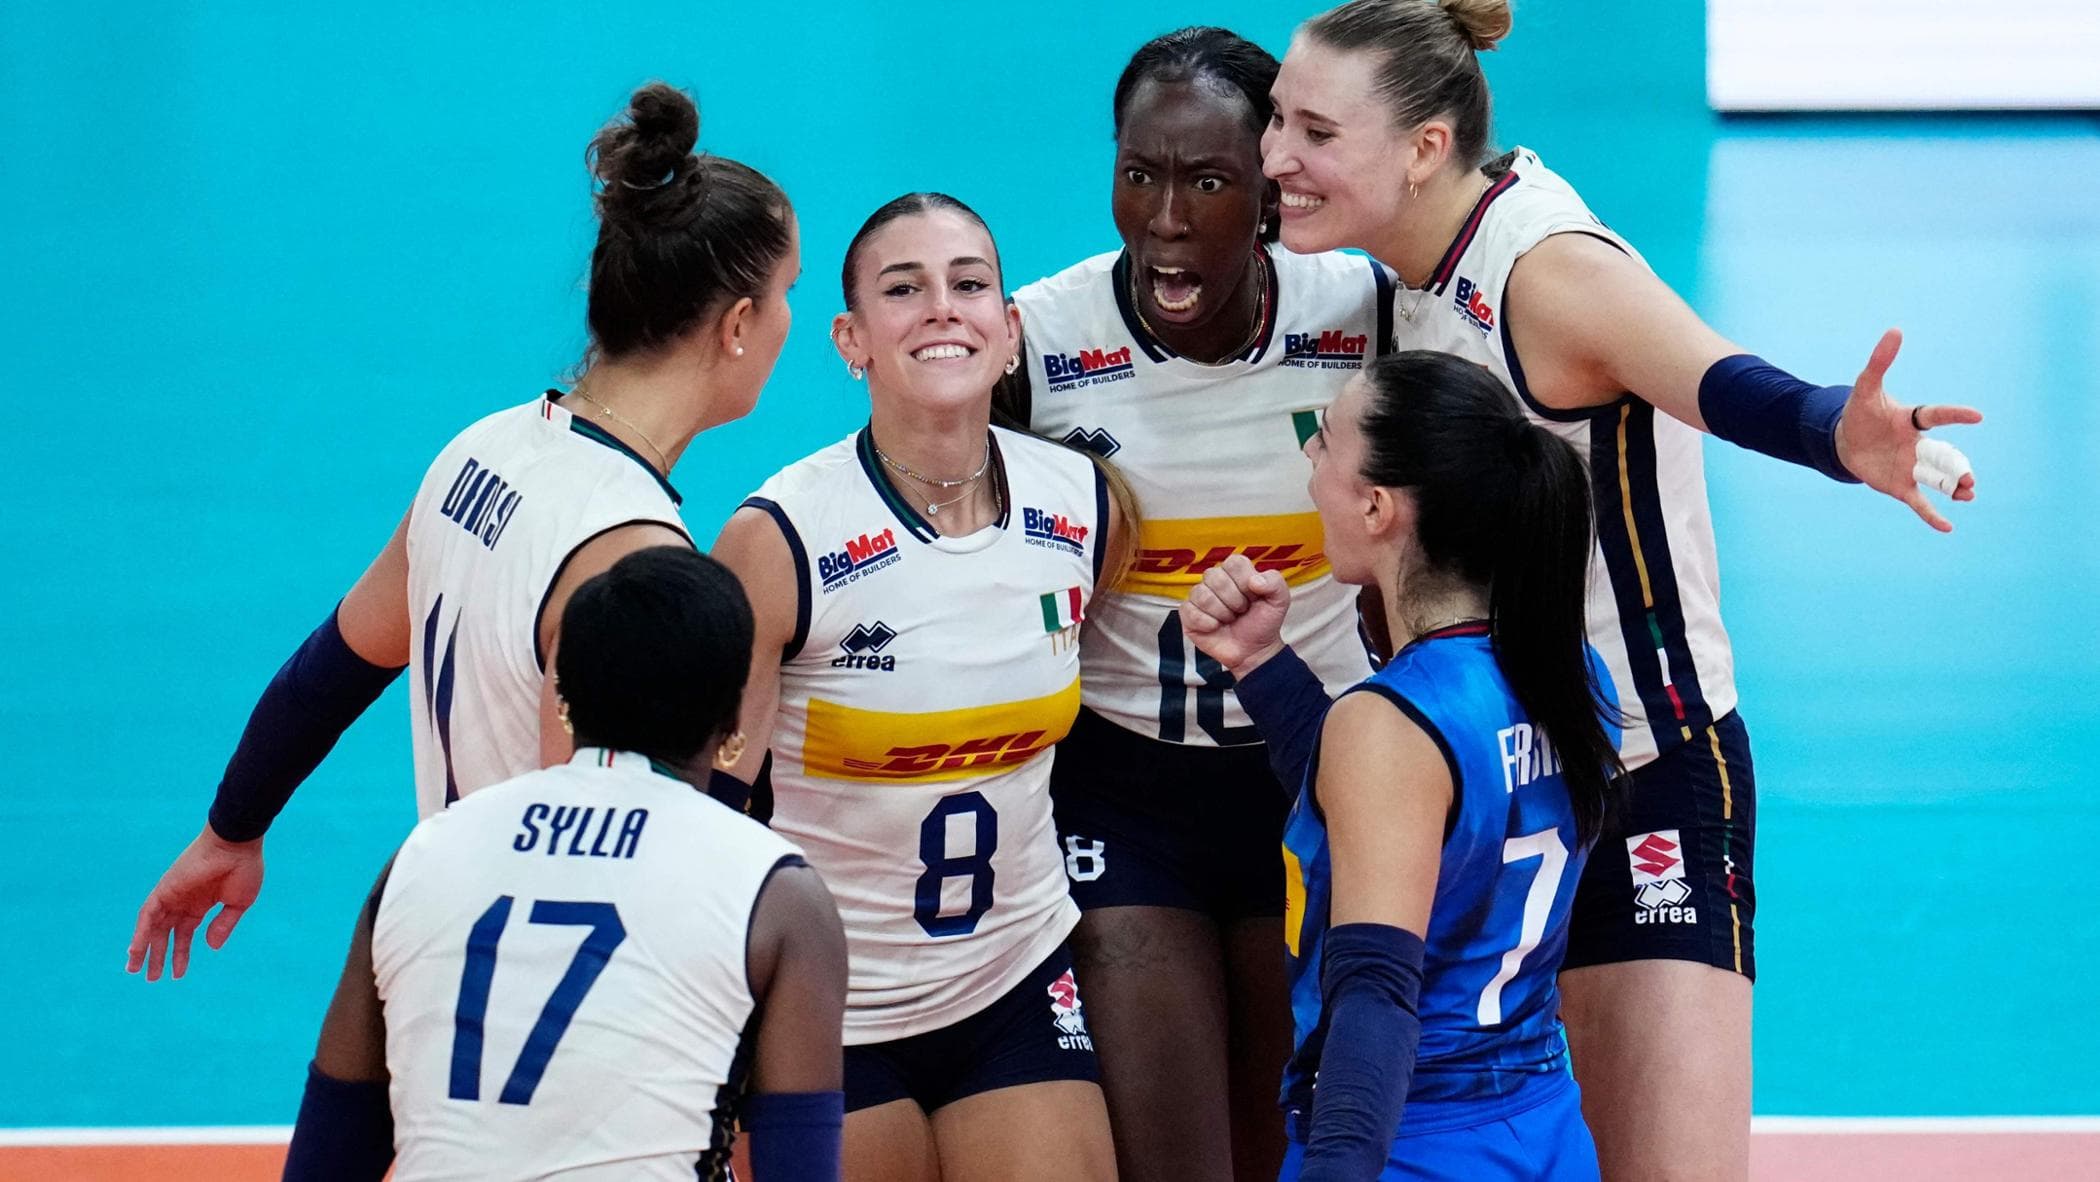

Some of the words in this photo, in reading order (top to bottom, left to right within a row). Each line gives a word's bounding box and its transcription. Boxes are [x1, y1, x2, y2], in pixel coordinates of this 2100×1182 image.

[1284, 330, 1367, 355] BigMat
[1043, 346, 1131, 379] BigMat
[1307, 360, 1320, 369] OF
[1321, 361, 1362, 370] BUILDERS
[1049, 382, 1076, 393] HOME
[1078, 379, 1090, 388] OF
[1092, 370, 1136, 385] BUILDERS
[1023, 507, 1089, 543] BigMat
[818, 528, 895, 580] BigMat
[1025, 537, 1046, 548] HOME
[1046, 541, 1055, 549] OF
[1136, 543, 1304, 575] DHL
[823, 578, 849, 595] HOME
[848, 572, 861, 583] OF
[861, 553, 902, 577] BUILDERS
[832, 654, 896, 672] errea
[877, 729, 1048, 772] DHL
[513, 803, 649, 859] SYLLA
[913, 790, 998, 938] 8
[1477, 826, 1569, 1026] 7
[1635, 906, 1697, 924] errea
[448, 894, 627, 1106] 17
